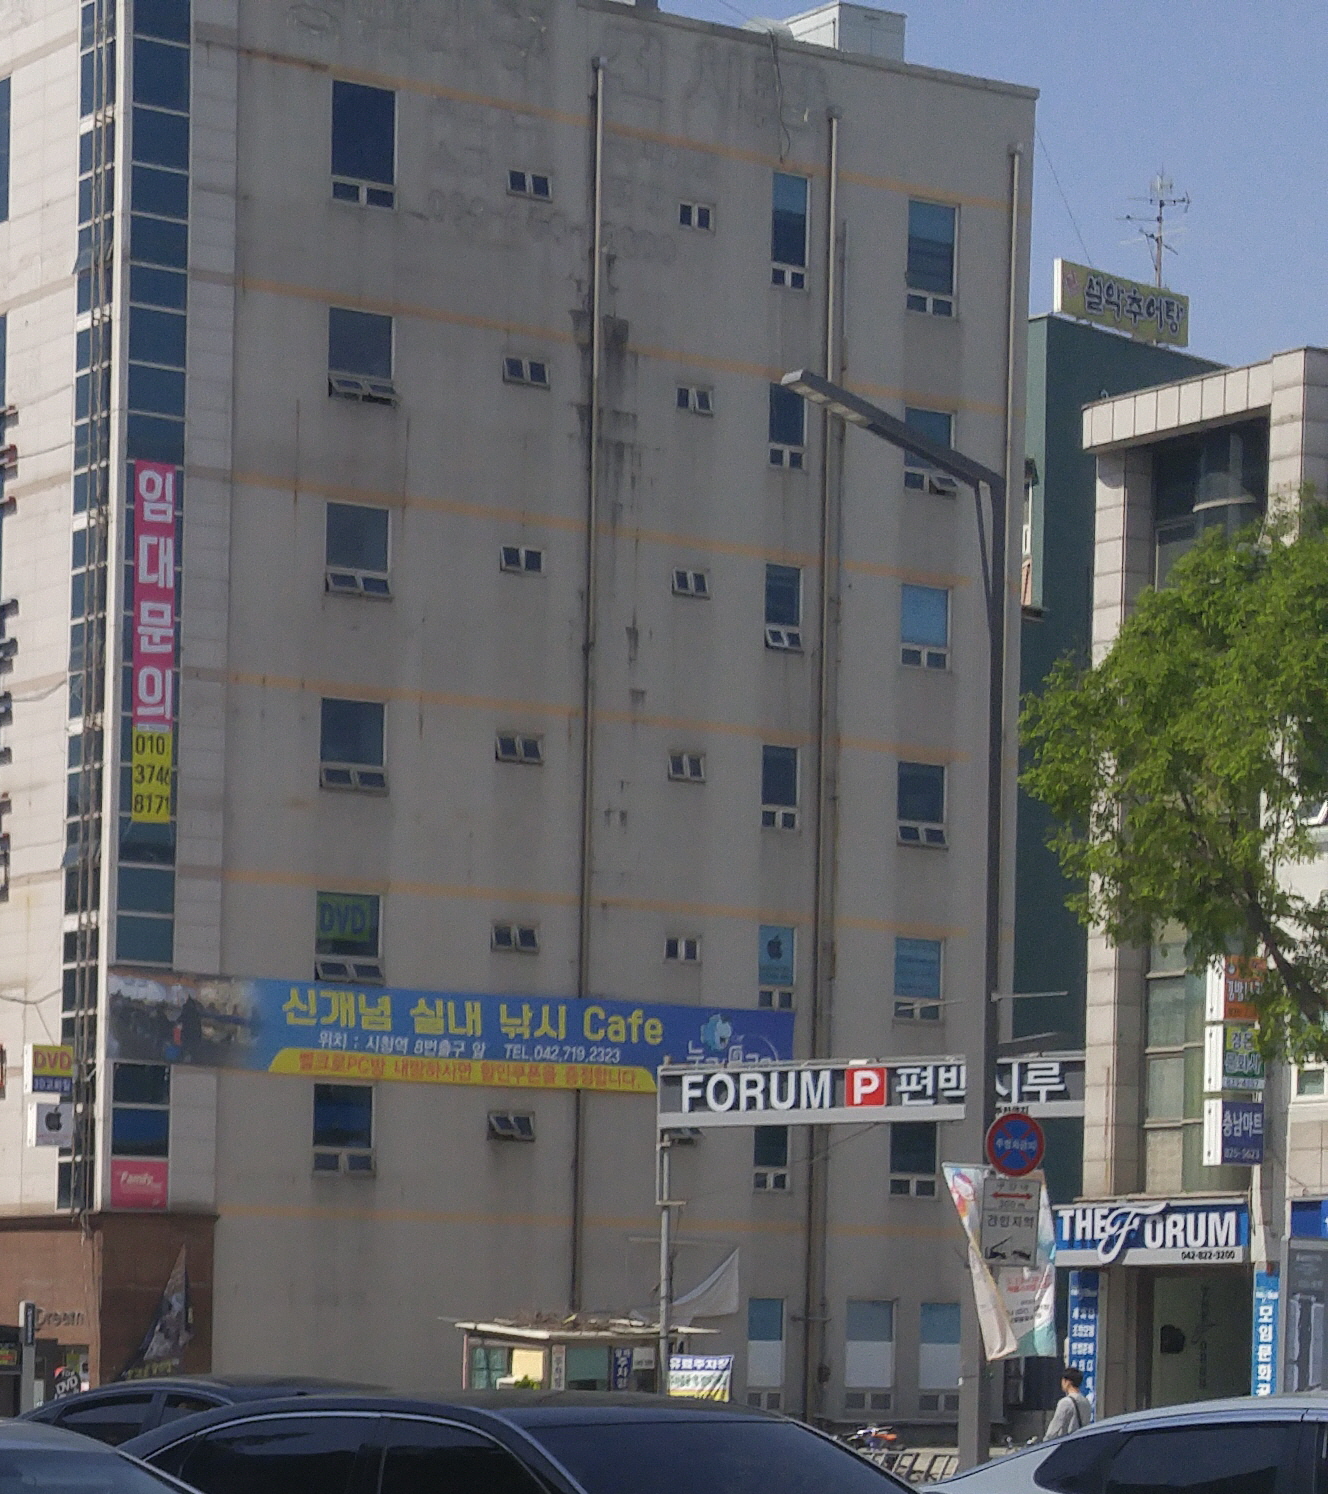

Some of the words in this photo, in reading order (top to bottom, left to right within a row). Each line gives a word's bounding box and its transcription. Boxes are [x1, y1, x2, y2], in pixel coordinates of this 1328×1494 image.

[1084, 274, 1185, 337] 설악추어탕
[137, 467, 175, 720] 임대문의
[135, 733, 166, 756] 010
[282, 987, 393, 1032] 신개념
[410, 997, 483, 1037] 실내
[500, 1003, 567, 1041] 낚시
[583, 1005, 664, 1045] Cafe
[317, 1032, 347, 1050] 위치
[33, 1051, 71, 1070] DVD
[682, 1070, 832, 1113] FORUM
[1223, 1109, 1263, 1137] 충남마트
[987, 1214, 1035, 1228] 견인지역
[1058, 1207, 1108, 1241] THE
[56, 1376, 78, 1393] DVD
